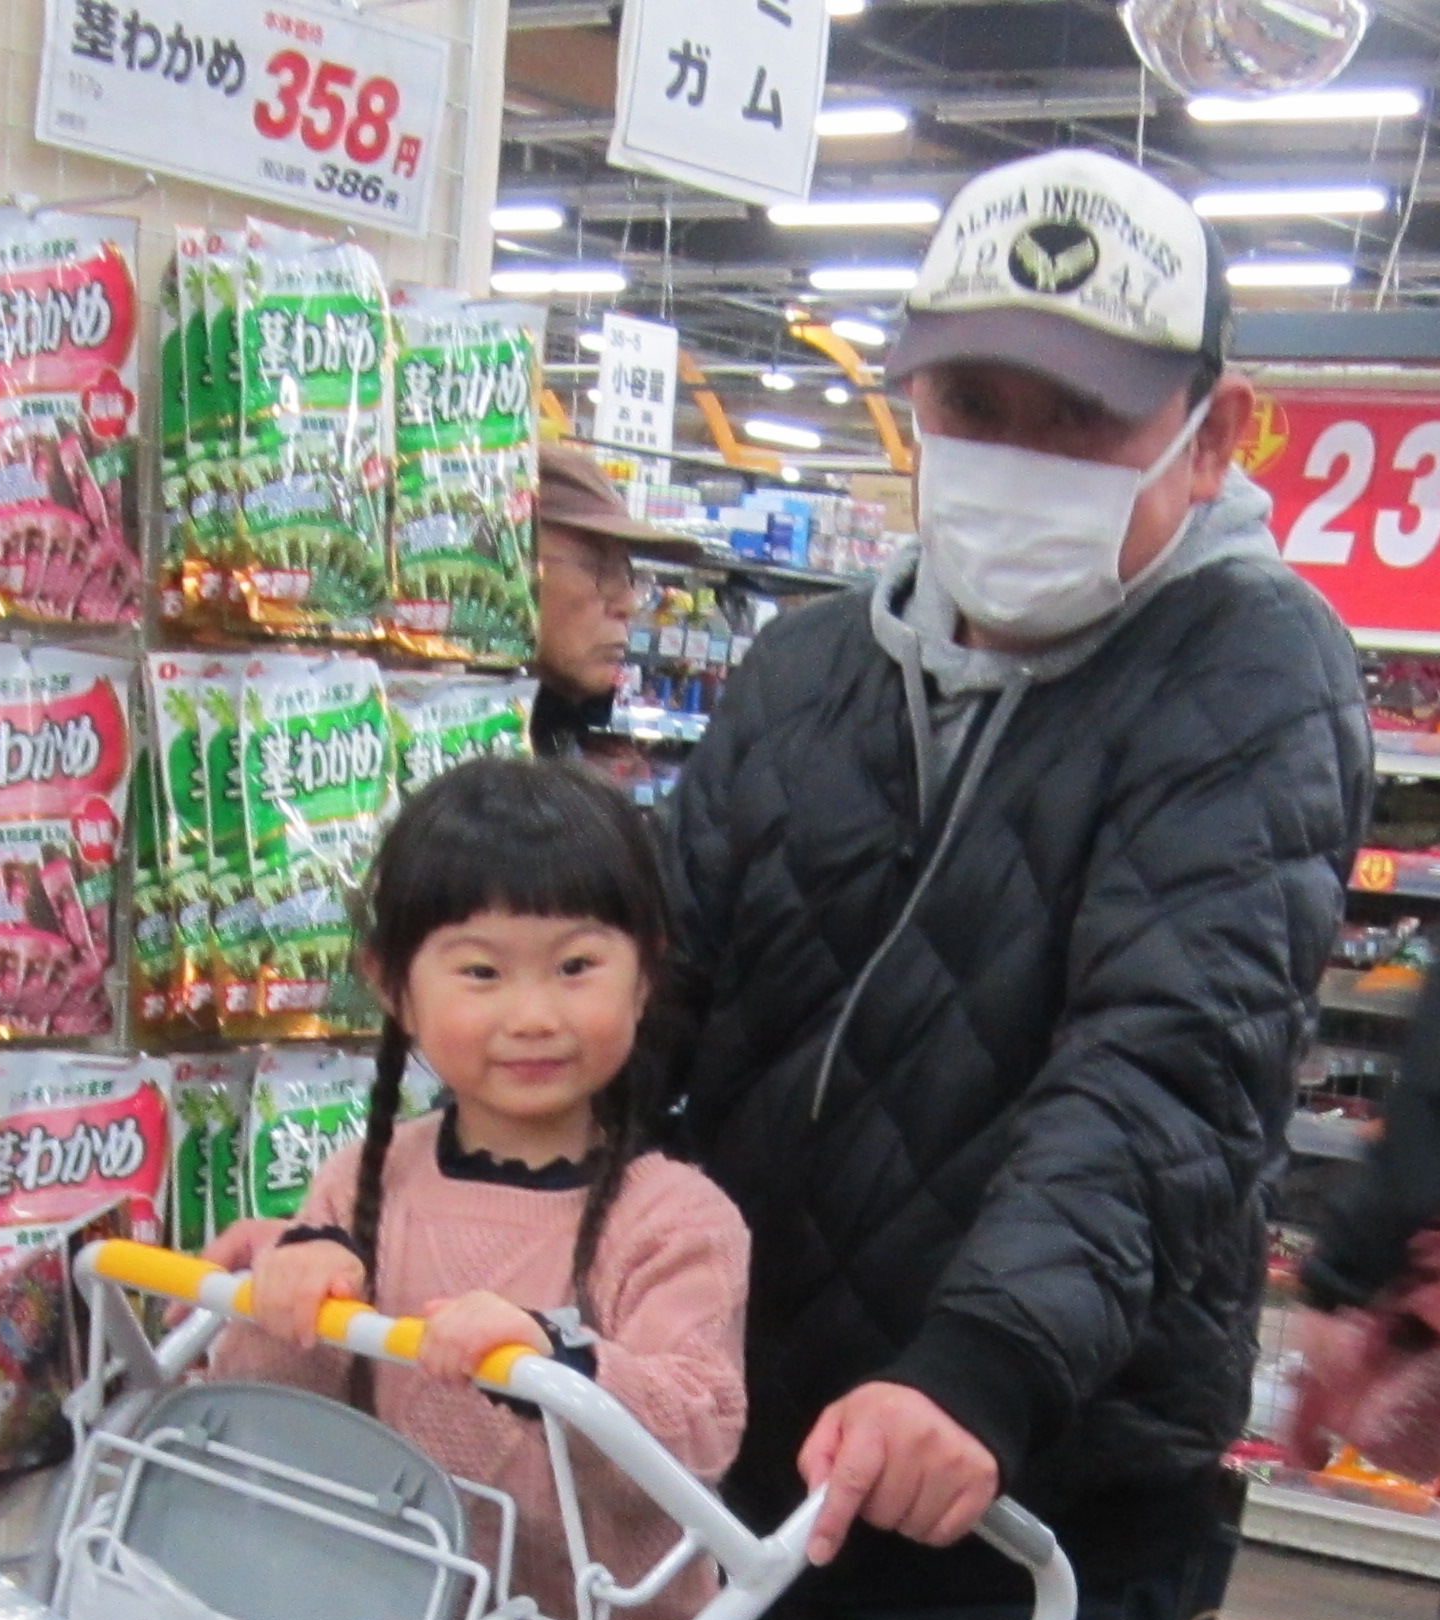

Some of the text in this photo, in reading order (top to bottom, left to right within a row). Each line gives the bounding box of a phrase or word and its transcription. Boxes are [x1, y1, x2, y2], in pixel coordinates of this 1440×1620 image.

[71, 0, 247, 97] 茎わかめ
[664, 37, 784, 130] ガム
[1042, 185, 1183, 278] INDUSTRIES
[258, 308, 377, 379] 茎わかめ
[400, 359, 528, 425] 茎わかめ
[260, 720, 386, 801] 茎わかめ
